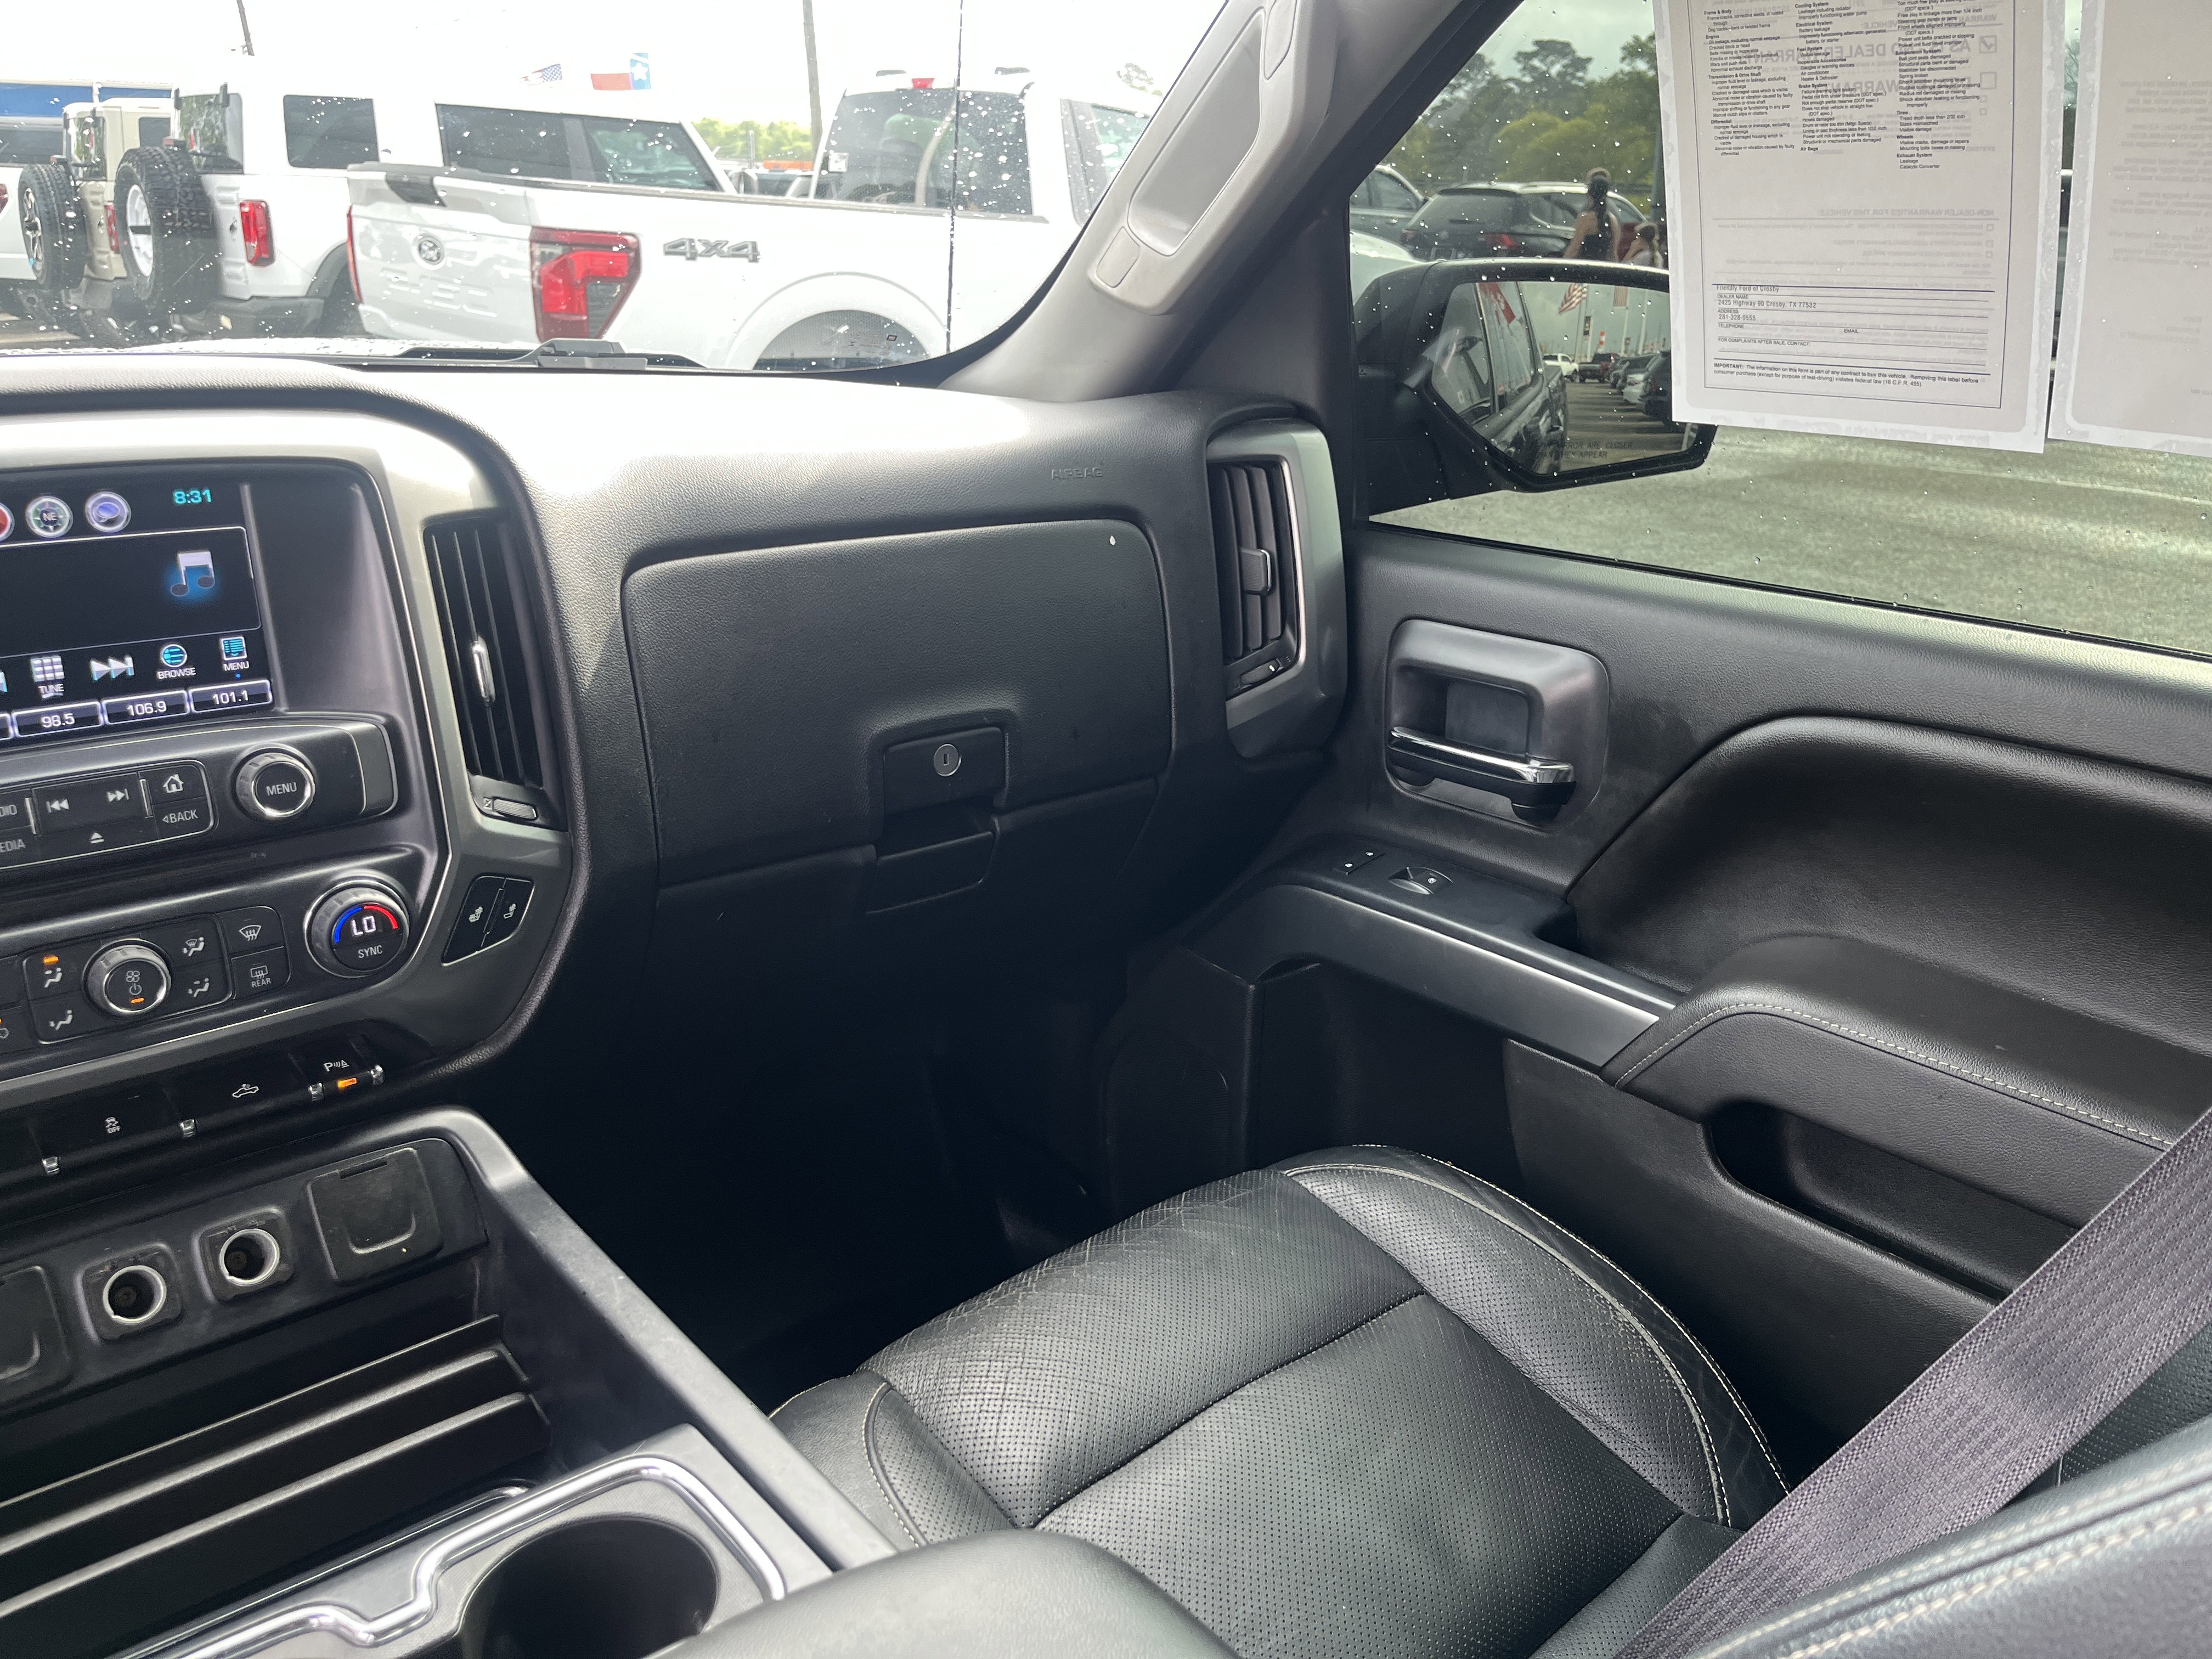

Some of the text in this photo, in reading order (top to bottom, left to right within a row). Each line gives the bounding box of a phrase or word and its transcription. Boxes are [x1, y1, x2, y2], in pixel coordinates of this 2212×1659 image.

[1051, 467, 1102, 479] AIRBAG
[173, 489, 213, 505] 8:31
[42, 512, 57, 521] NE
[223, 661, 249, 671] MENU
[157, 667, 196, 679] BROWSE
[38, 684, 64, 693] TUNE
[213, 690, 249, 705] 101.1
[127, 701, 167, 716] 106.9
[41, 713, 75, 728] 98.5
[266, 782, 297, 795] MENU
[170, 809, 198, 823] BACK
[358, 945, 383, 958] SYNC
[252, 978, 271, 988] REAR
